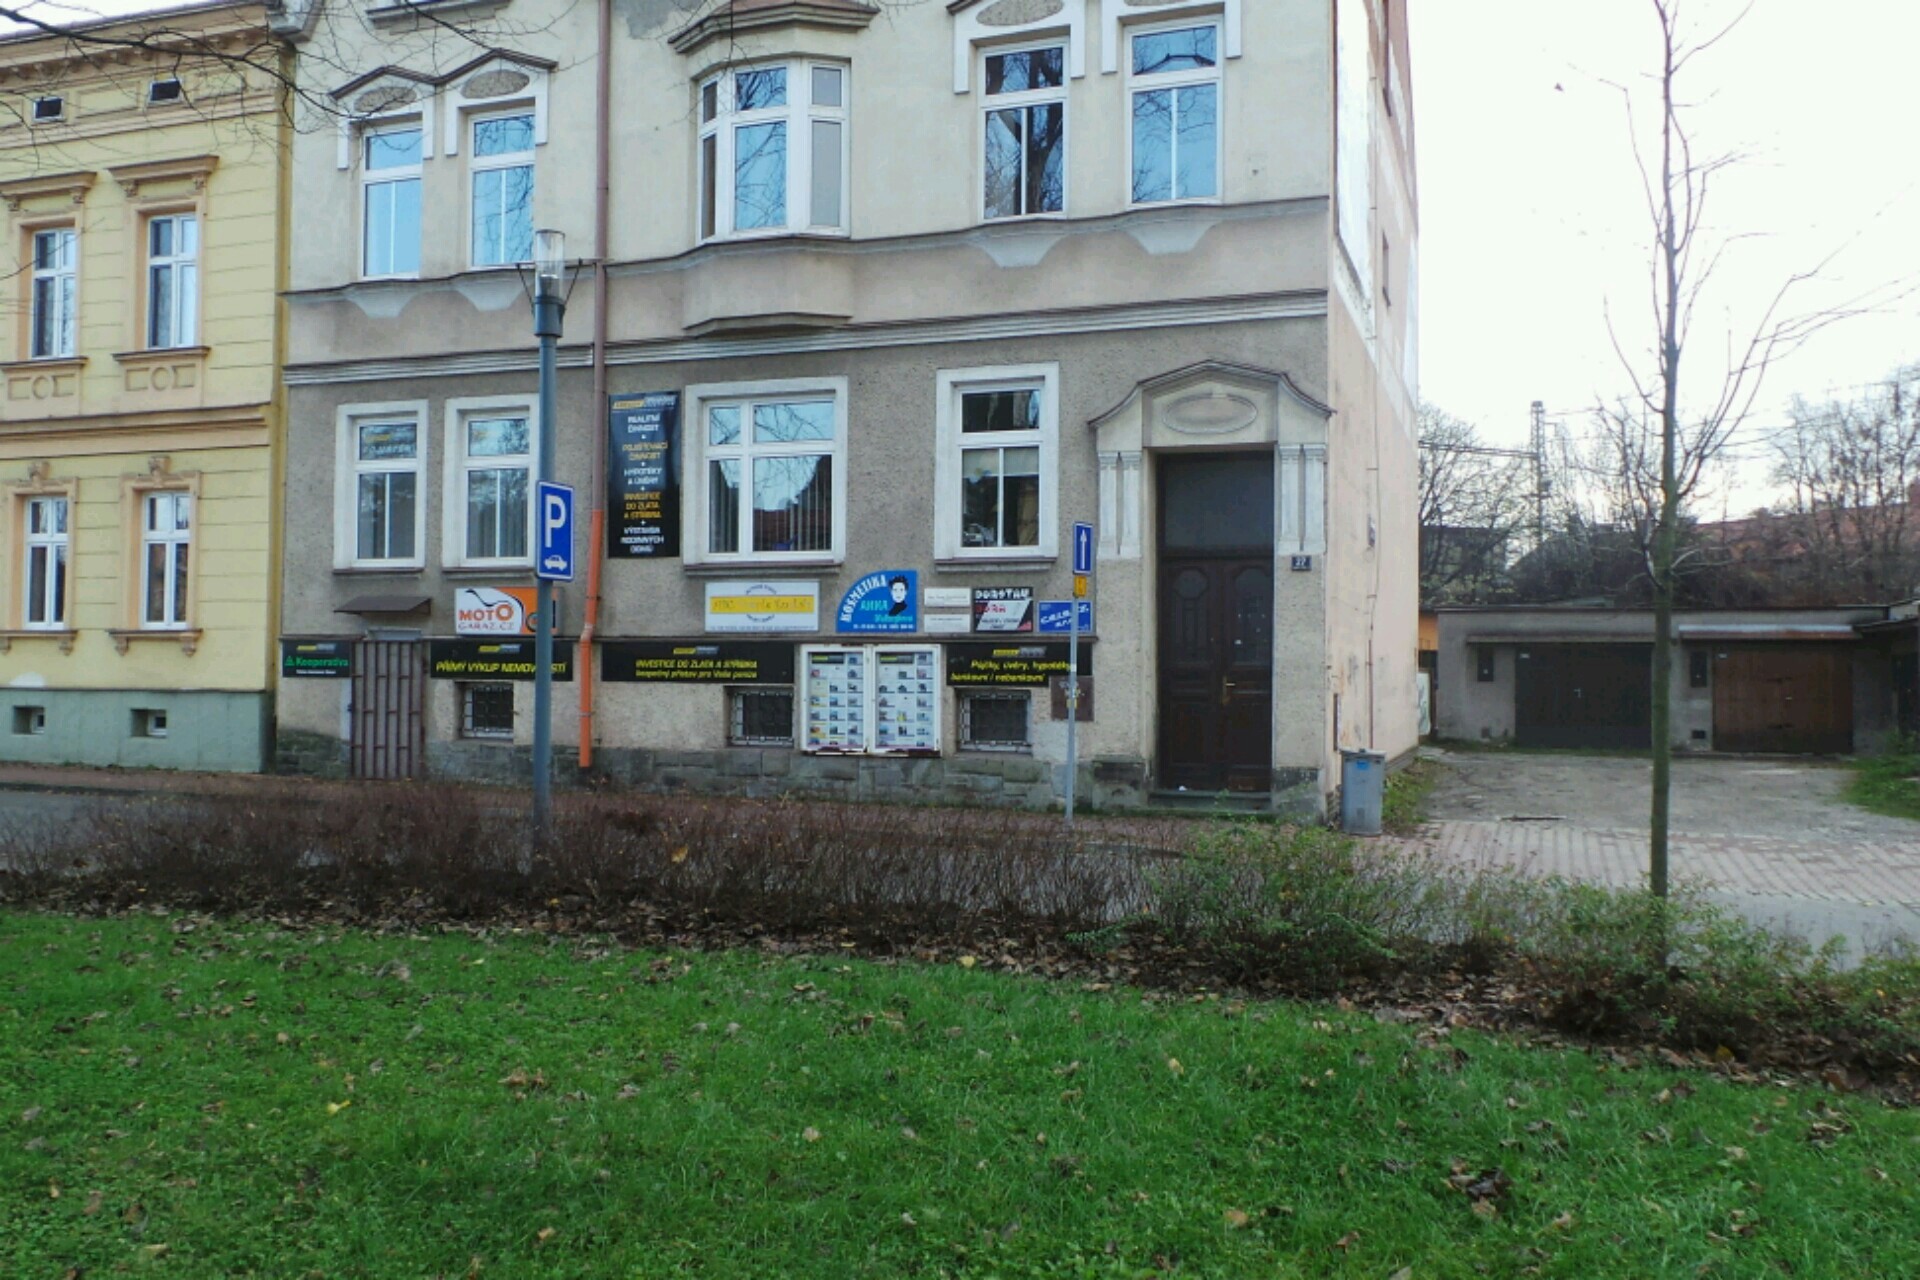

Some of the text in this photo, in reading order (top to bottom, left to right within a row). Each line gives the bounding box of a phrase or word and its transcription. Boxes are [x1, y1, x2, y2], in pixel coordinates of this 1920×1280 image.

[545, 493, 567, 548] P
[459, 604, 513, 622] MOTO
[501, 661, 567, 673] NEMOVSTÍ
